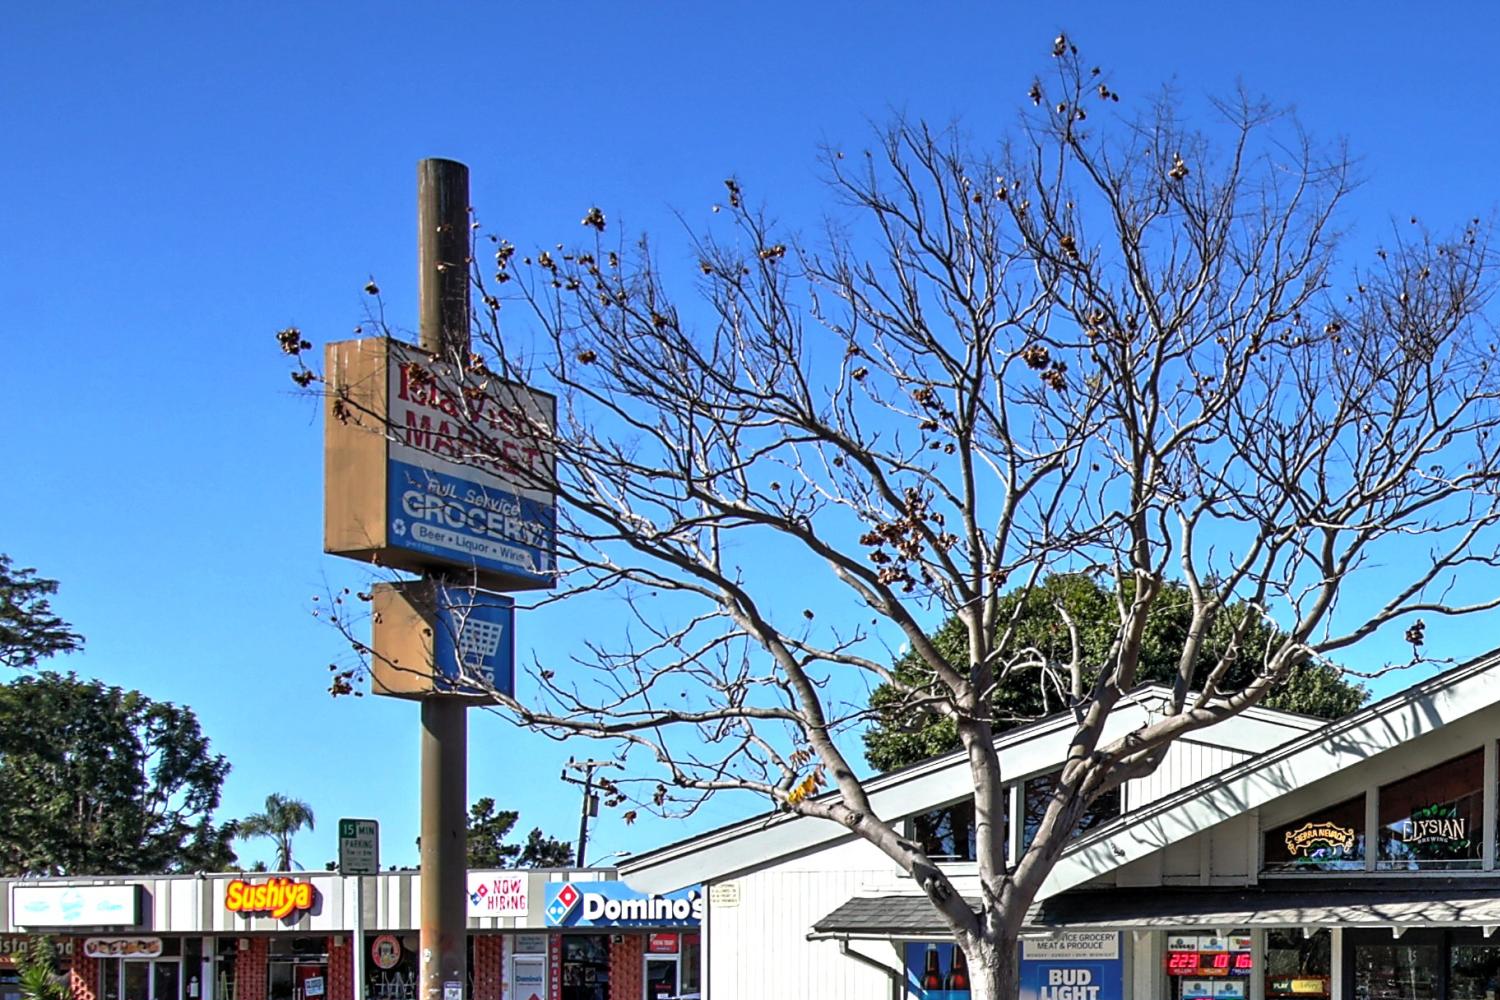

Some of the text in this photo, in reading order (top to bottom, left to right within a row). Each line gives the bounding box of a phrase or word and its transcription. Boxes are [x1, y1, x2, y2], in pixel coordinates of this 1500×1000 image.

[465, 489, 520, 517] Service
[402, 490, 544, 547] GROCERY
[419, 526, 446, 543] Beer
[455, 536, 489, 556] Liquor
[343, 824, 354, 836] 15
[1294, 829, 1318, 843] SIERRA
[1402, 818, 1464, 842] ELYSIAN
[1418, 836, 1448, 844] BREWING
[493, 879, 522, 894] NOW
[225, 877, 312, 919] Sushiya
[487, 895, 526, 910] HIRING
[583, 890, 702, 921] Domino's
[1037, 942, 1104, 950] MEAT & PRODUCE
[1169, 954, 1198, 968] 223
[1049, 969, 1092, 985] BUD
